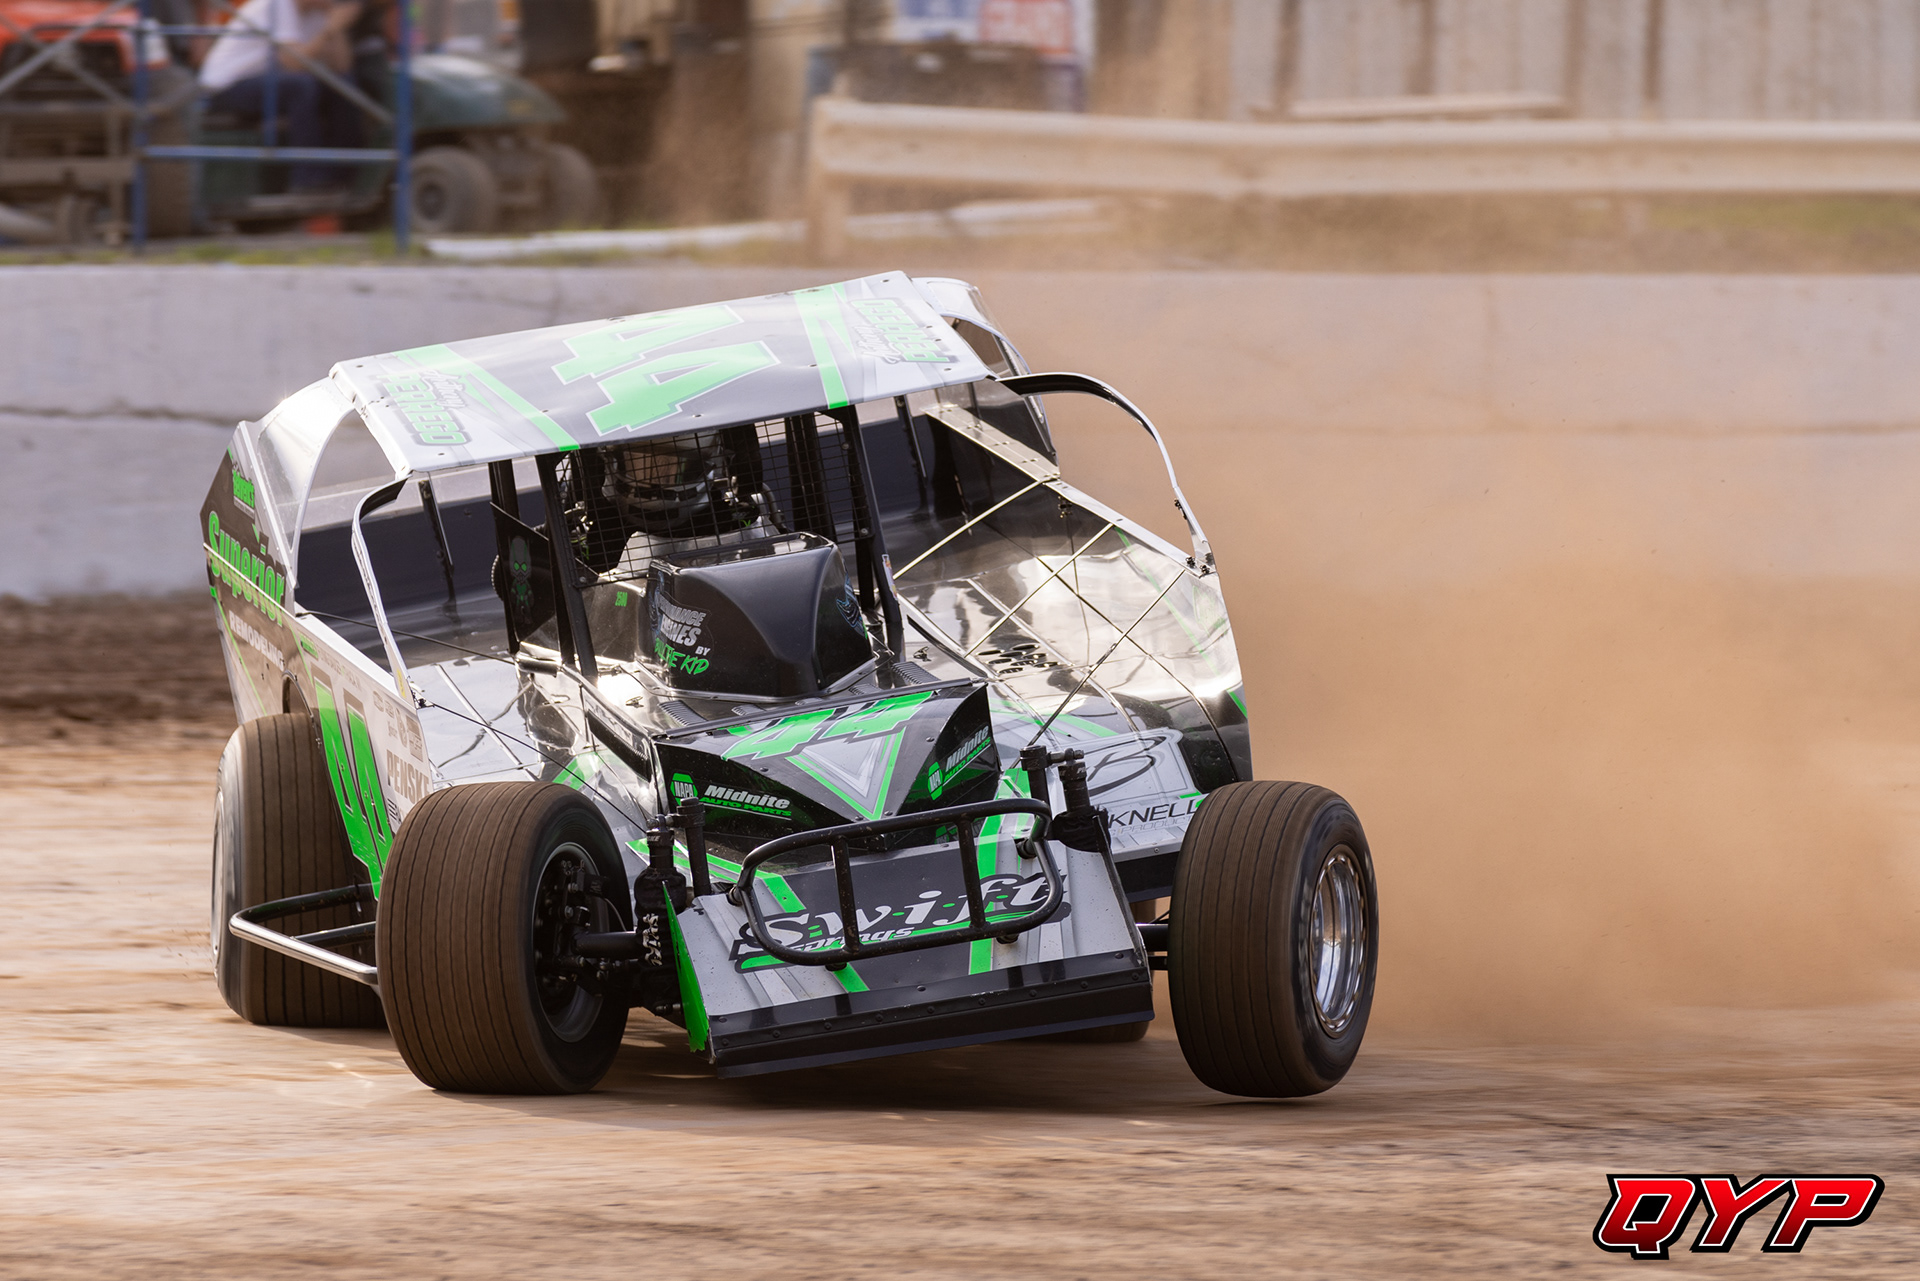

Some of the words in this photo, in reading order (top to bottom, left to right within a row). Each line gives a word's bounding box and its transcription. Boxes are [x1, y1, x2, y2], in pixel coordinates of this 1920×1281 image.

[850, 299, 951, 362] PERREGO
[552, 304, 781, 436] 44
[376, 371, 468, 445] PERREGO
[208, 511, 286, 628] Superior
[228, 609, 285, 672] REMODELING
[694, 645, 711, 656] BY
[680, 655, 709, 675] KID
[720, 690, 935, 763] 44
[945, 725, 989, 773] Midnite
[386, 749, 431, 805] PENSKE
[674, 781, 694, 798] NAPA
[704, 784, 791, 810] Midnite
[929, 769, 942, 793] NAPA
[700, 797, 742, 808] AUTO
[743, 803, 792, 817] PARTS
[1107, 798, 1197, 829] KNELL
